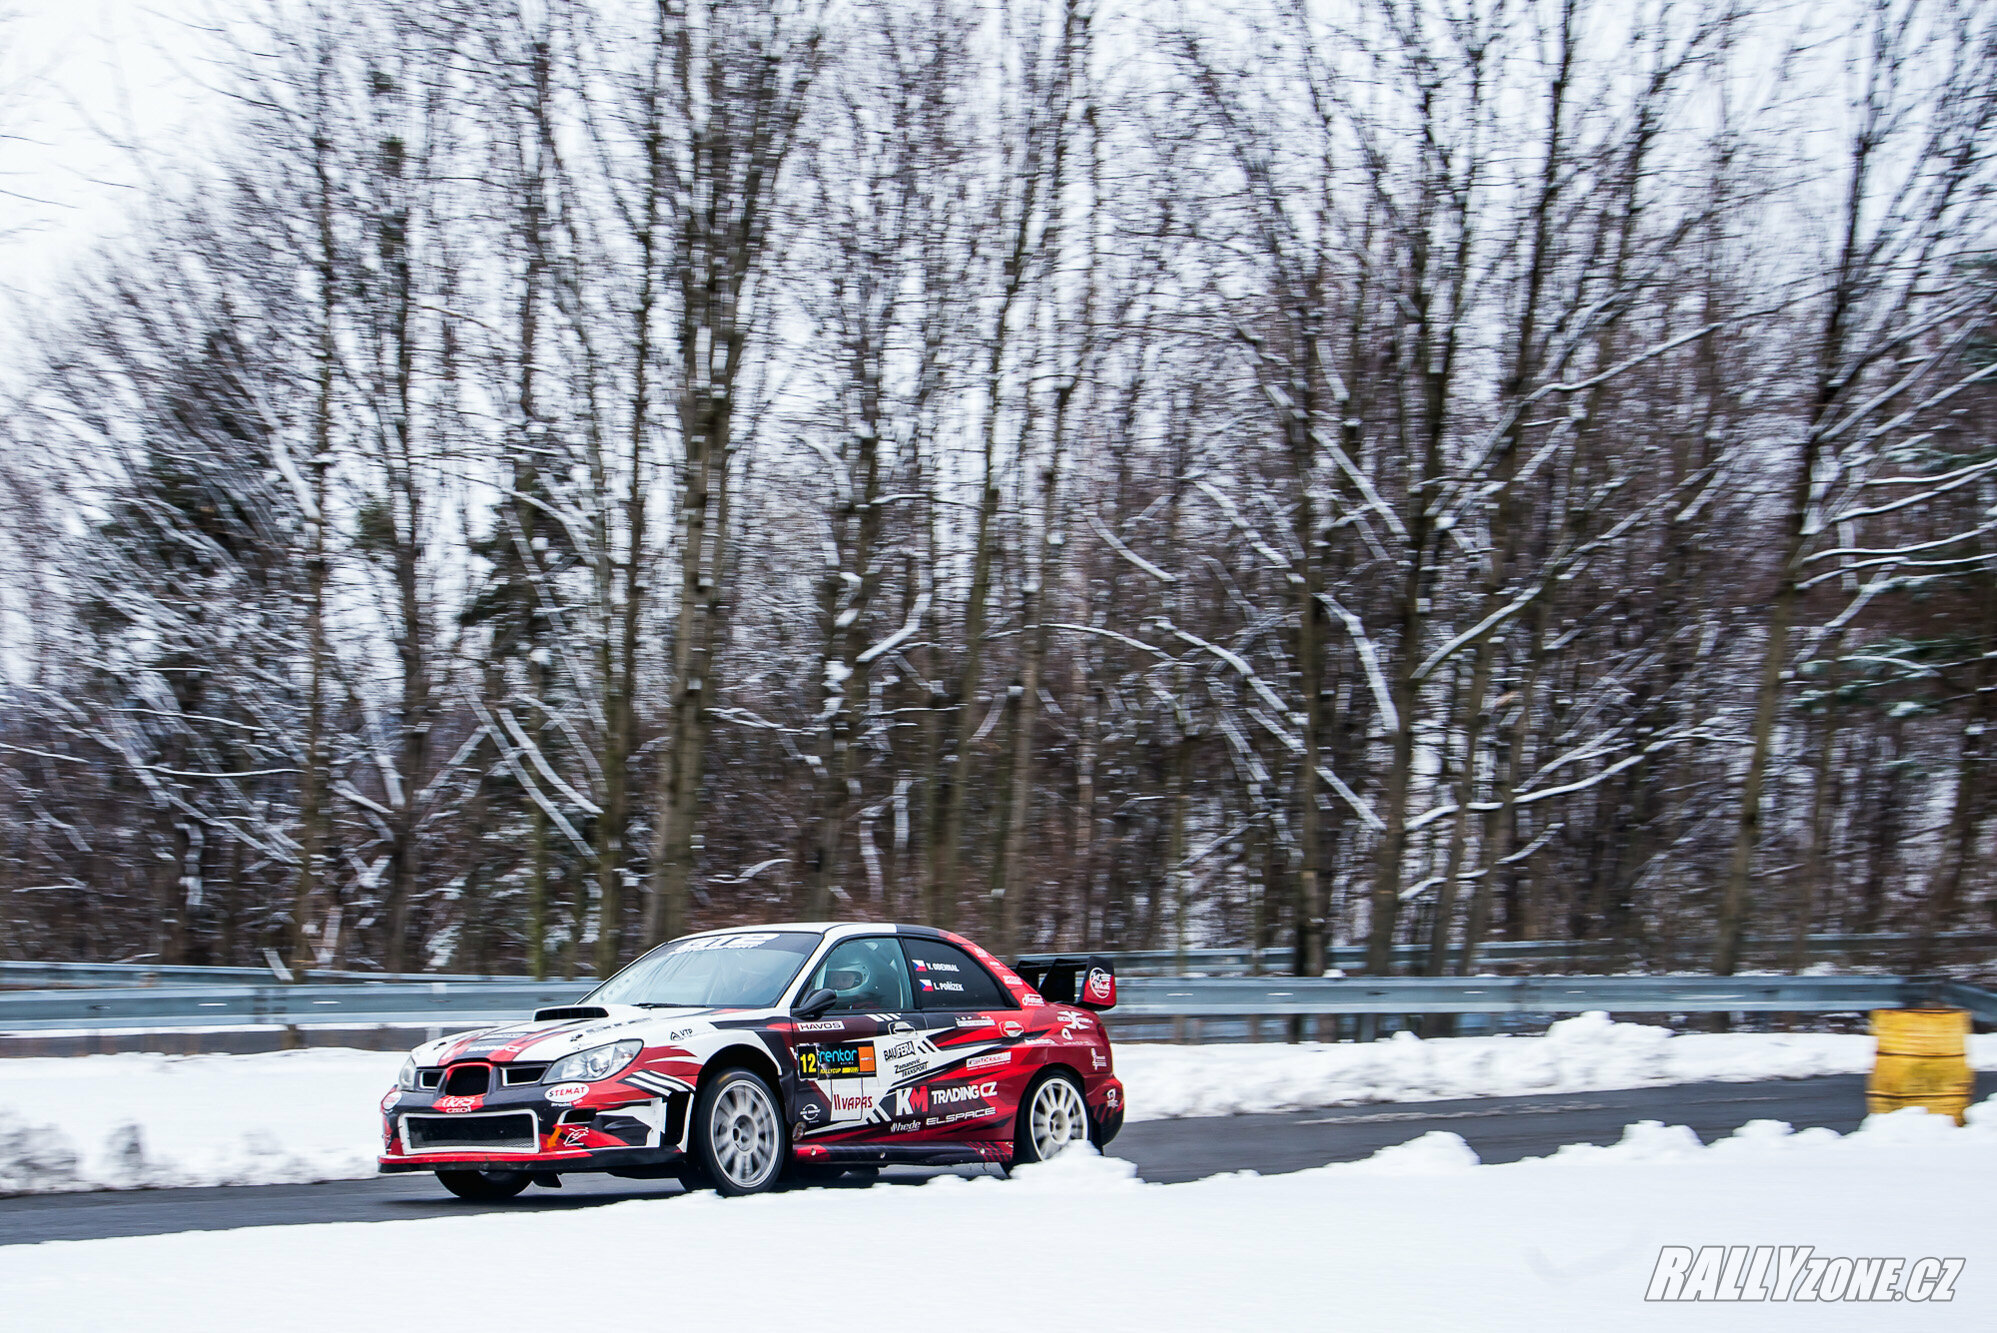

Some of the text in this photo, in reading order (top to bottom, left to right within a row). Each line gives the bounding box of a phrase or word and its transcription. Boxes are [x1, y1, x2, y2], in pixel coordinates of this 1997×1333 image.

[800, 1022, 841, 1030] HAVOS
[800, 1053, 816, 1073] 12
[819, 1048, 857, 1063] rentor
[902, 1063, 928, 1077] TRANSPORT
[549, 1086, 586, 1097] STEMAT
[895, 1081, 998, 1116] KM TRADING CZ
[926, 1107, 996, 1126] ELSPACE
